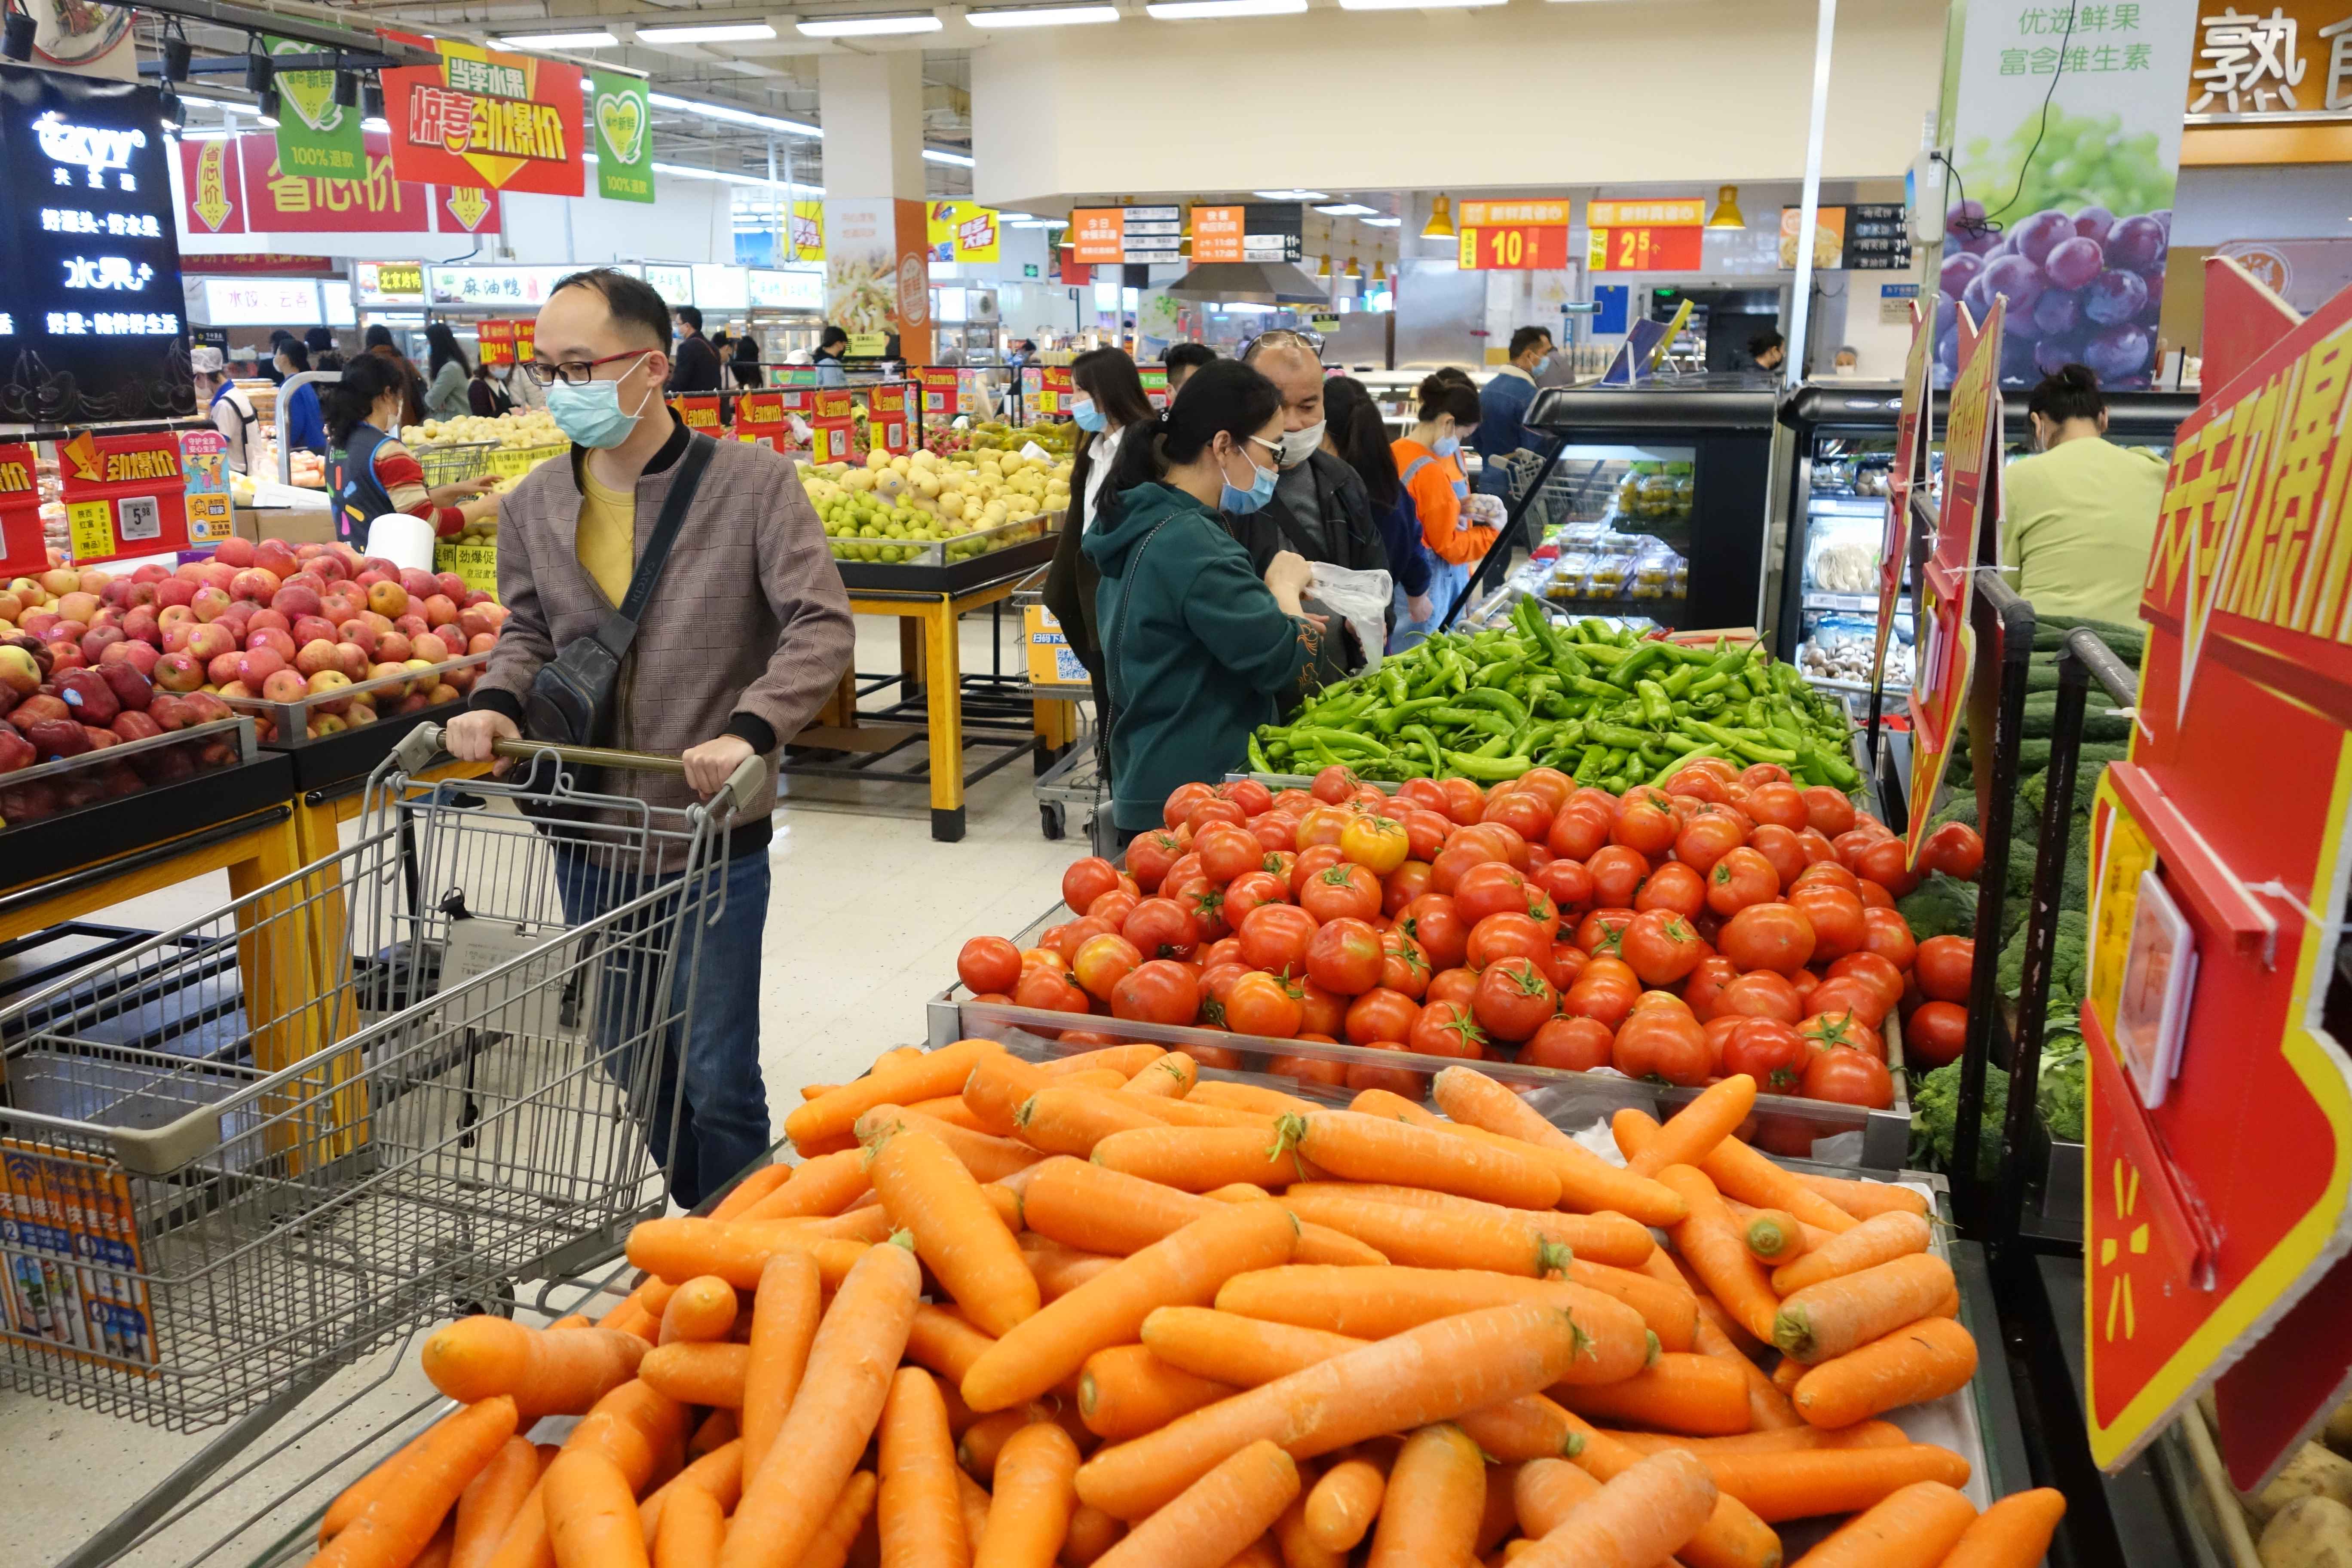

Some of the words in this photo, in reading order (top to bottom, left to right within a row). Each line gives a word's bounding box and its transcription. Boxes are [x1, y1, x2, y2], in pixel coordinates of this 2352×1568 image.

[2018, 4, 2140, 35] 优选鲜果
[2000, 44, 2151, 76] 富含维生素
[451, 58, 527, 98] 当季水果
[410, 85, 472, 155] 惊喜
[471, 97, 567, 160] 劲爆价
[291, 147, 354, 168] 100%退款
[203, 147, 220, 205] 省心价
[267, 156, 401, 212] 省心价
[1491, 230, 1522, 265] 10
[381, 272, 421, 289] 北京烤鸭
[462, 278, 521, 297] 麻油鸭
[0, 462, 32, 492] 价
[106, 450, 178, 482] 劲爆价
[2146, 318, 2352, 733] 劲爆
[459, 550, 497, 564] 劲爆促
[1032, 633, 1068, 643] 扫码下单
